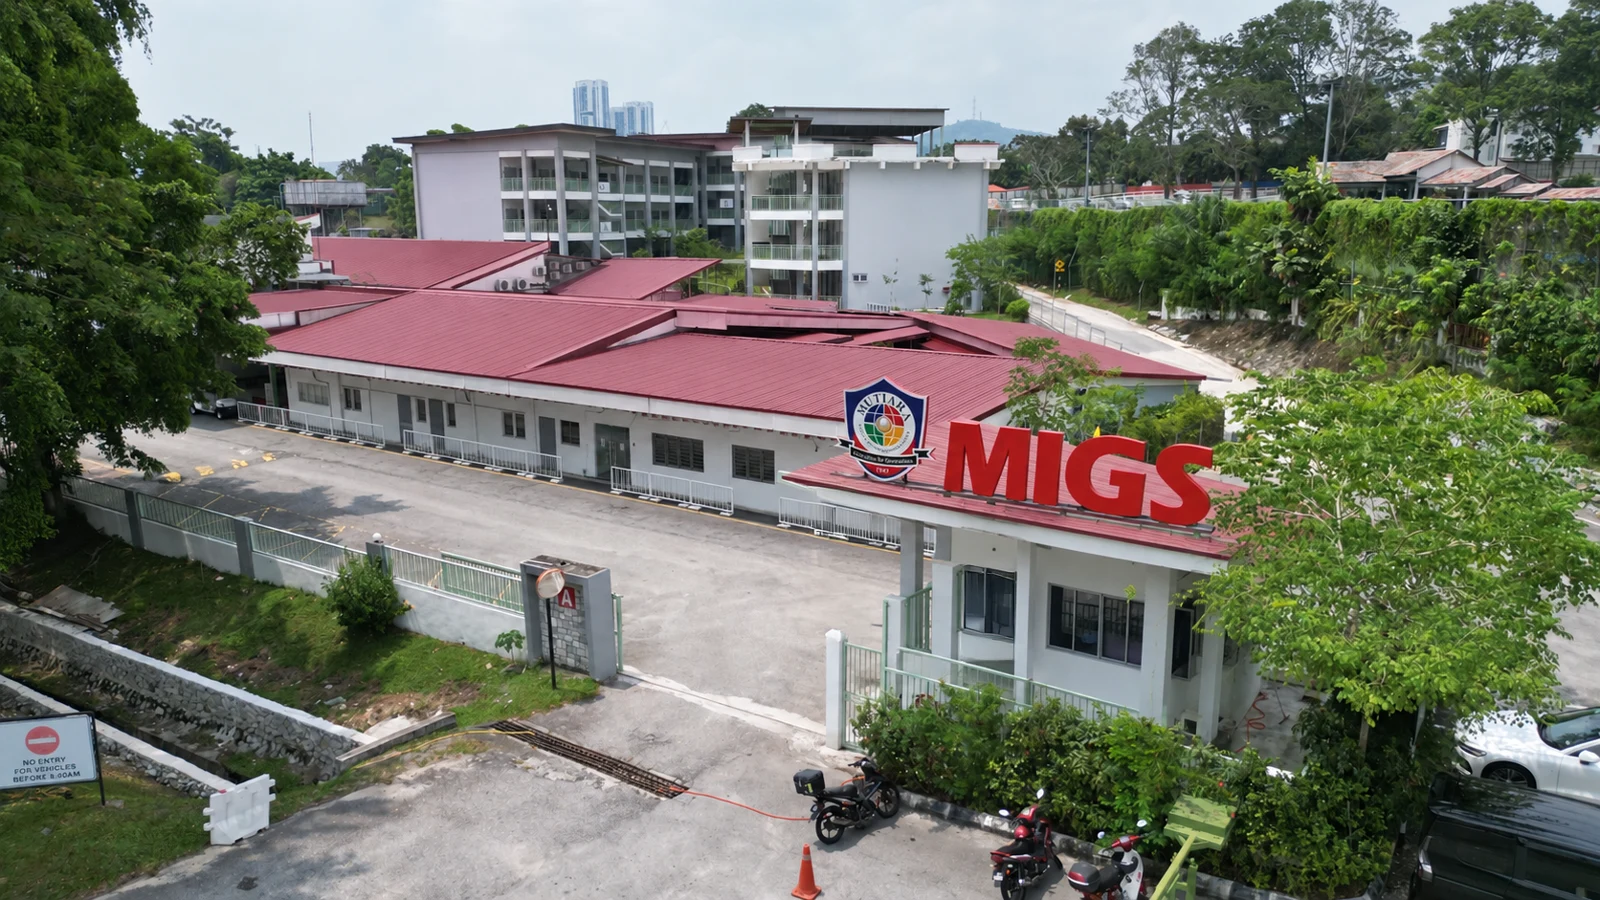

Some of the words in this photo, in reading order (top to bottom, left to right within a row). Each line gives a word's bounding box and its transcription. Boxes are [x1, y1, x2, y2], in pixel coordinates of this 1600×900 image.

[857, 393, 911, 422] MUTIARA
[943, 421, 1213, 526] MIGS
[562, 589, 572, 606] A
[38, 756, 66, 764] ENTRY
[34, 764, 76, 772] VEHICLES
[12, 774, 46, 782] BEFORE
